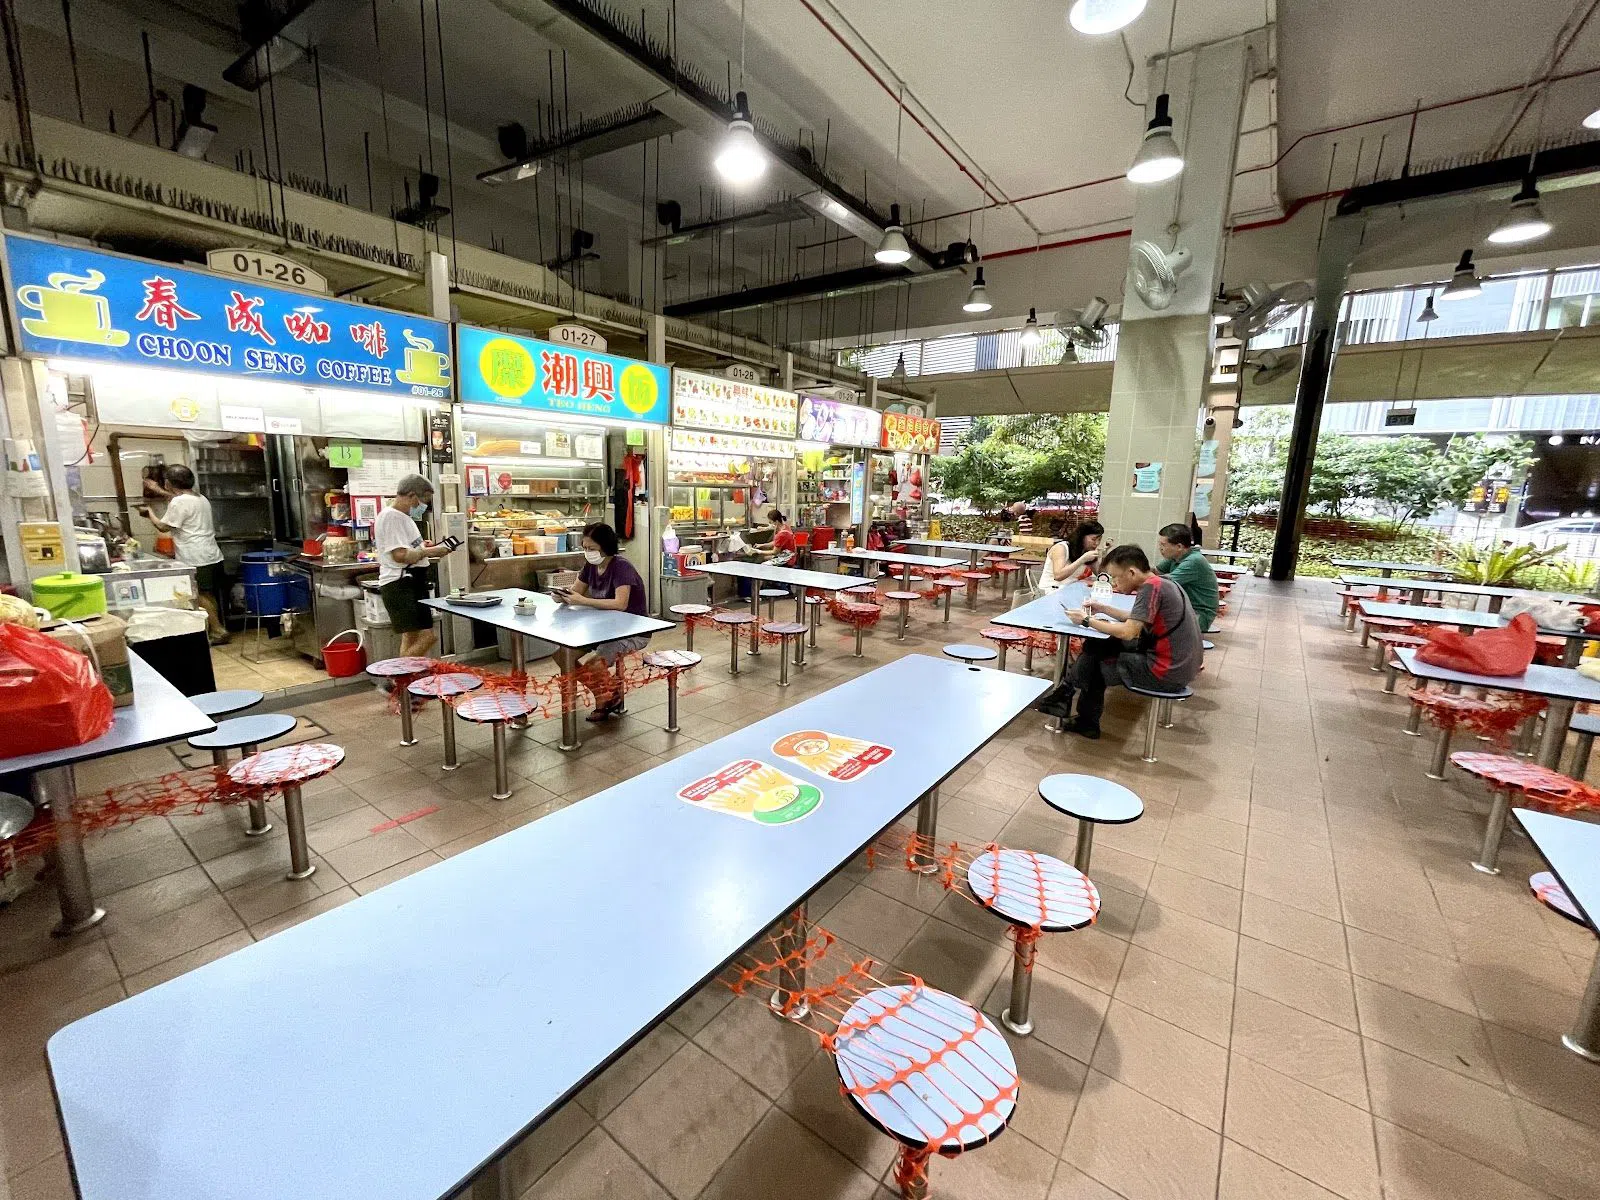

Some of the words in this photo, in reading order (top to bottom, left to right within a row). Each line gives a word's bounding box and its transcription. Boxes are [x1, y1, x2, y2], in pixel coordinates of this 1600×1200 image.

[233, 253, 306, 285] 01-26
[561, 328, 596, 346] 01-27
[138, 334, 232, 366] CHOON
[245, 349, 306, 375] SENG
[318, 359, 391, 385] COFFEE
[733, 367, 754, 381] 01-28
[541, 350, 614, 402] 潮興
